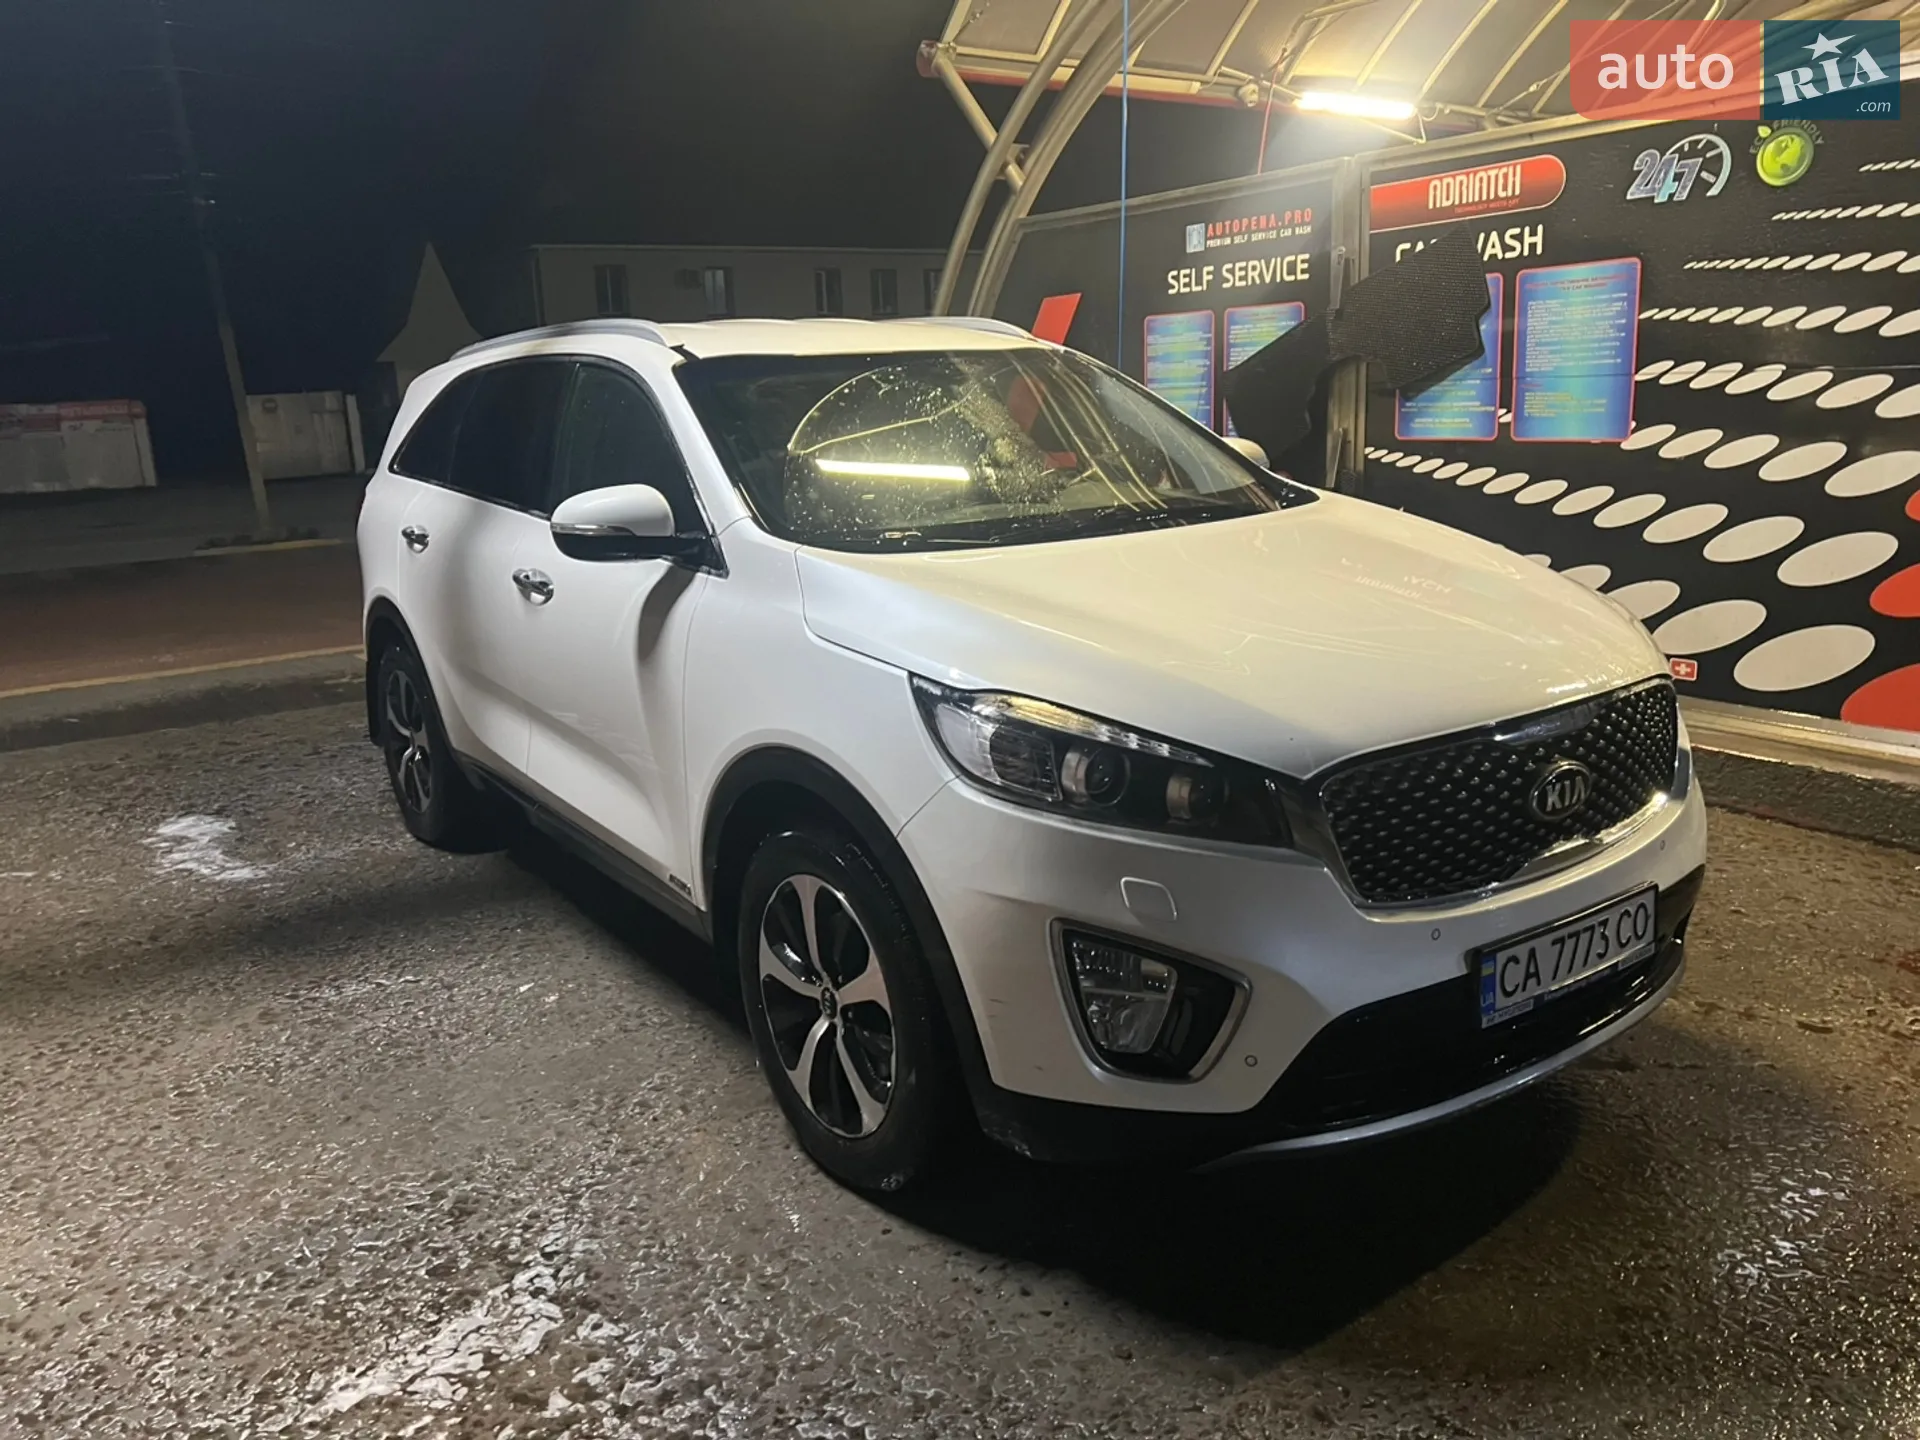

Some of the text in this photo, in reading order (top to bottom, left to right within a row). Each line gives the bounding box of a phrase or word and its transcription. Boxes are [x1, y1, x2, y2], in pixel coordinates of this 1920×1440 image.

[1773, 119, 1824, 144] FRIENDLY
[1233, 234, 1248, 244] SELF
[1251, 230, 1277, 242] SERVICE
[1280, 227, 1292, 237] CAR
[1295, 225, 1312, 235] WASH
[1167, 253, 1310, 295] SELF SERVICE
[1545, 775, 1586, 812] KIA
[1501, 946, 1541, 998] CA
[1551, 917, 1609, 981] 7773
[1616, 902, 1649, 948] CO
[1481, 991, 1494, 1007] UA
